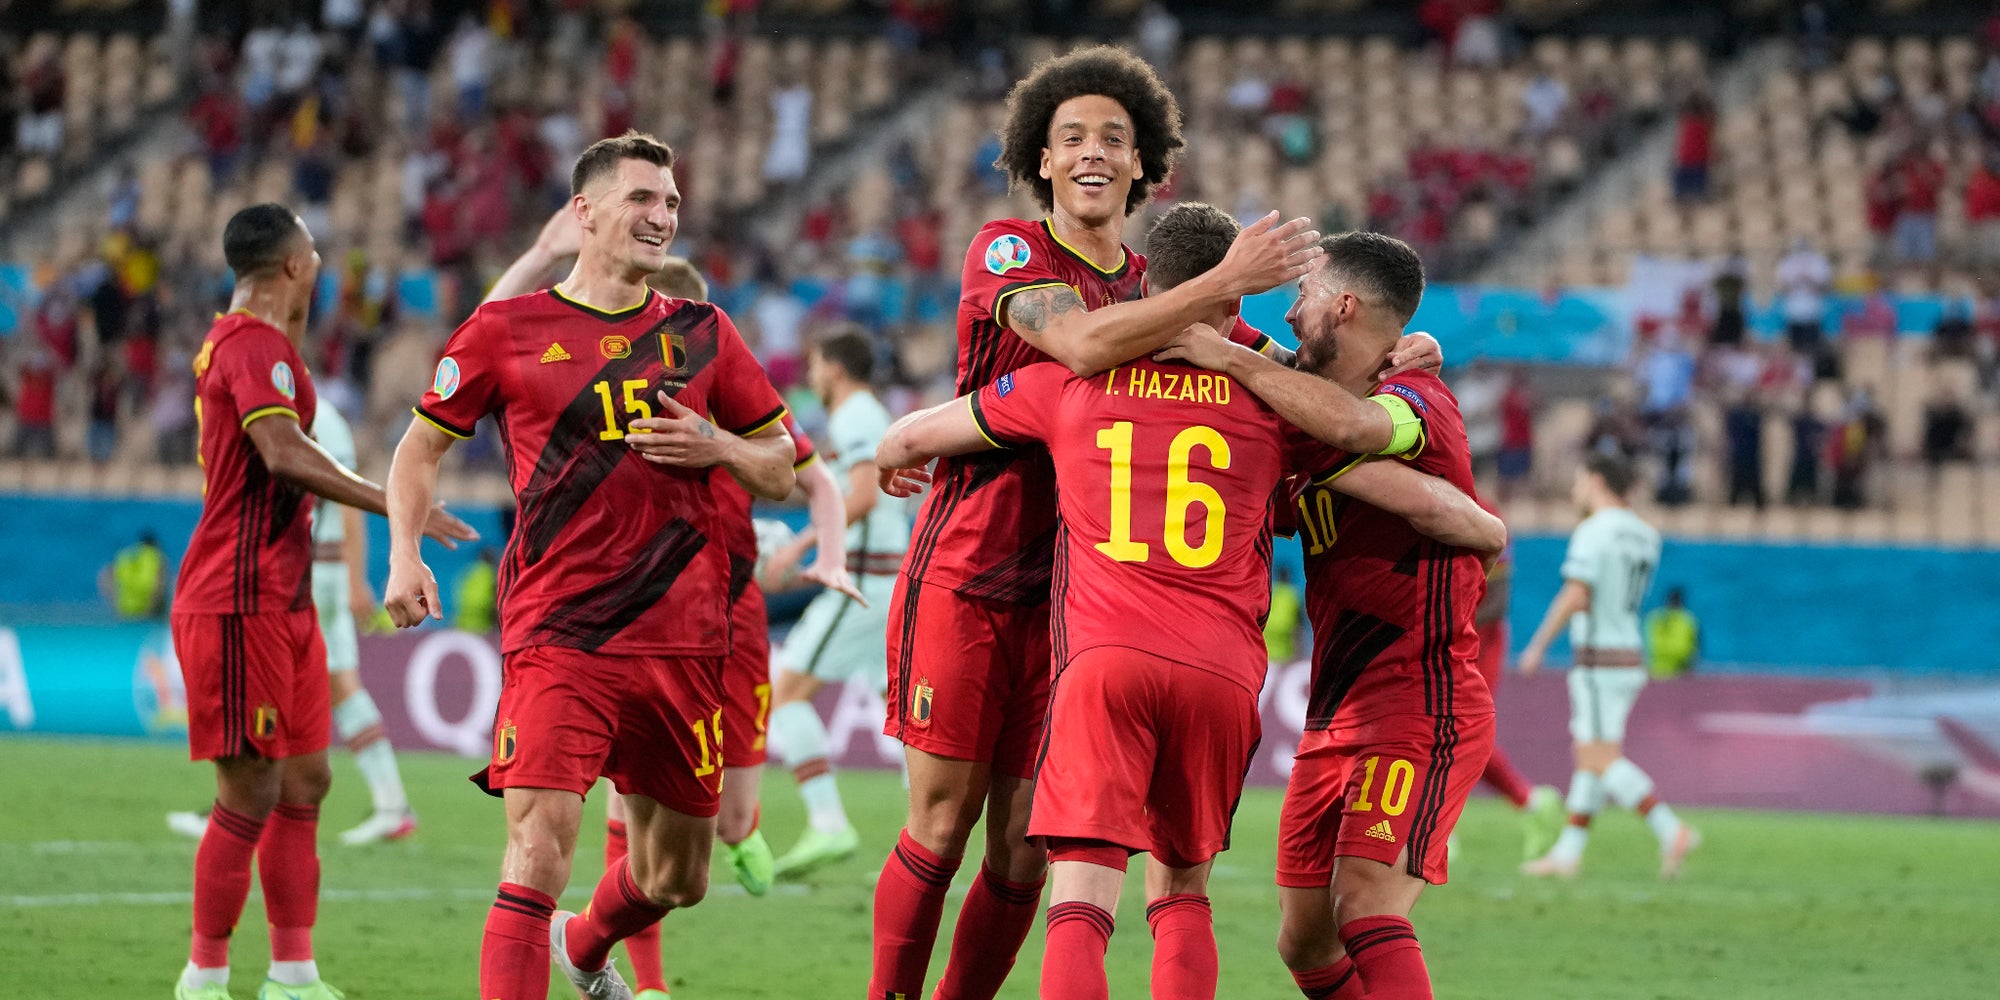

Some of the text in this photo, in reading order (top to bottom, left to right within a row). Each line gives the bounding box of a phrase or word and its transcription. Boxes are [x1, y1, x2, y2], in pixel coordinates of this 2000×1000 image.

[540, 352, 571, 364] adidas
[593, 379, 653, 441] 15
[1128, 367, 1231, 405] HAZARD
[1395, 386, 1427, 413] RESPEC
[1094, 421, 1231, 568] 16
[1298, 489, 1338, 555] 10
[1351, 756, 1415, 816] 10
[1365, 829, 1396, 843] adidas
